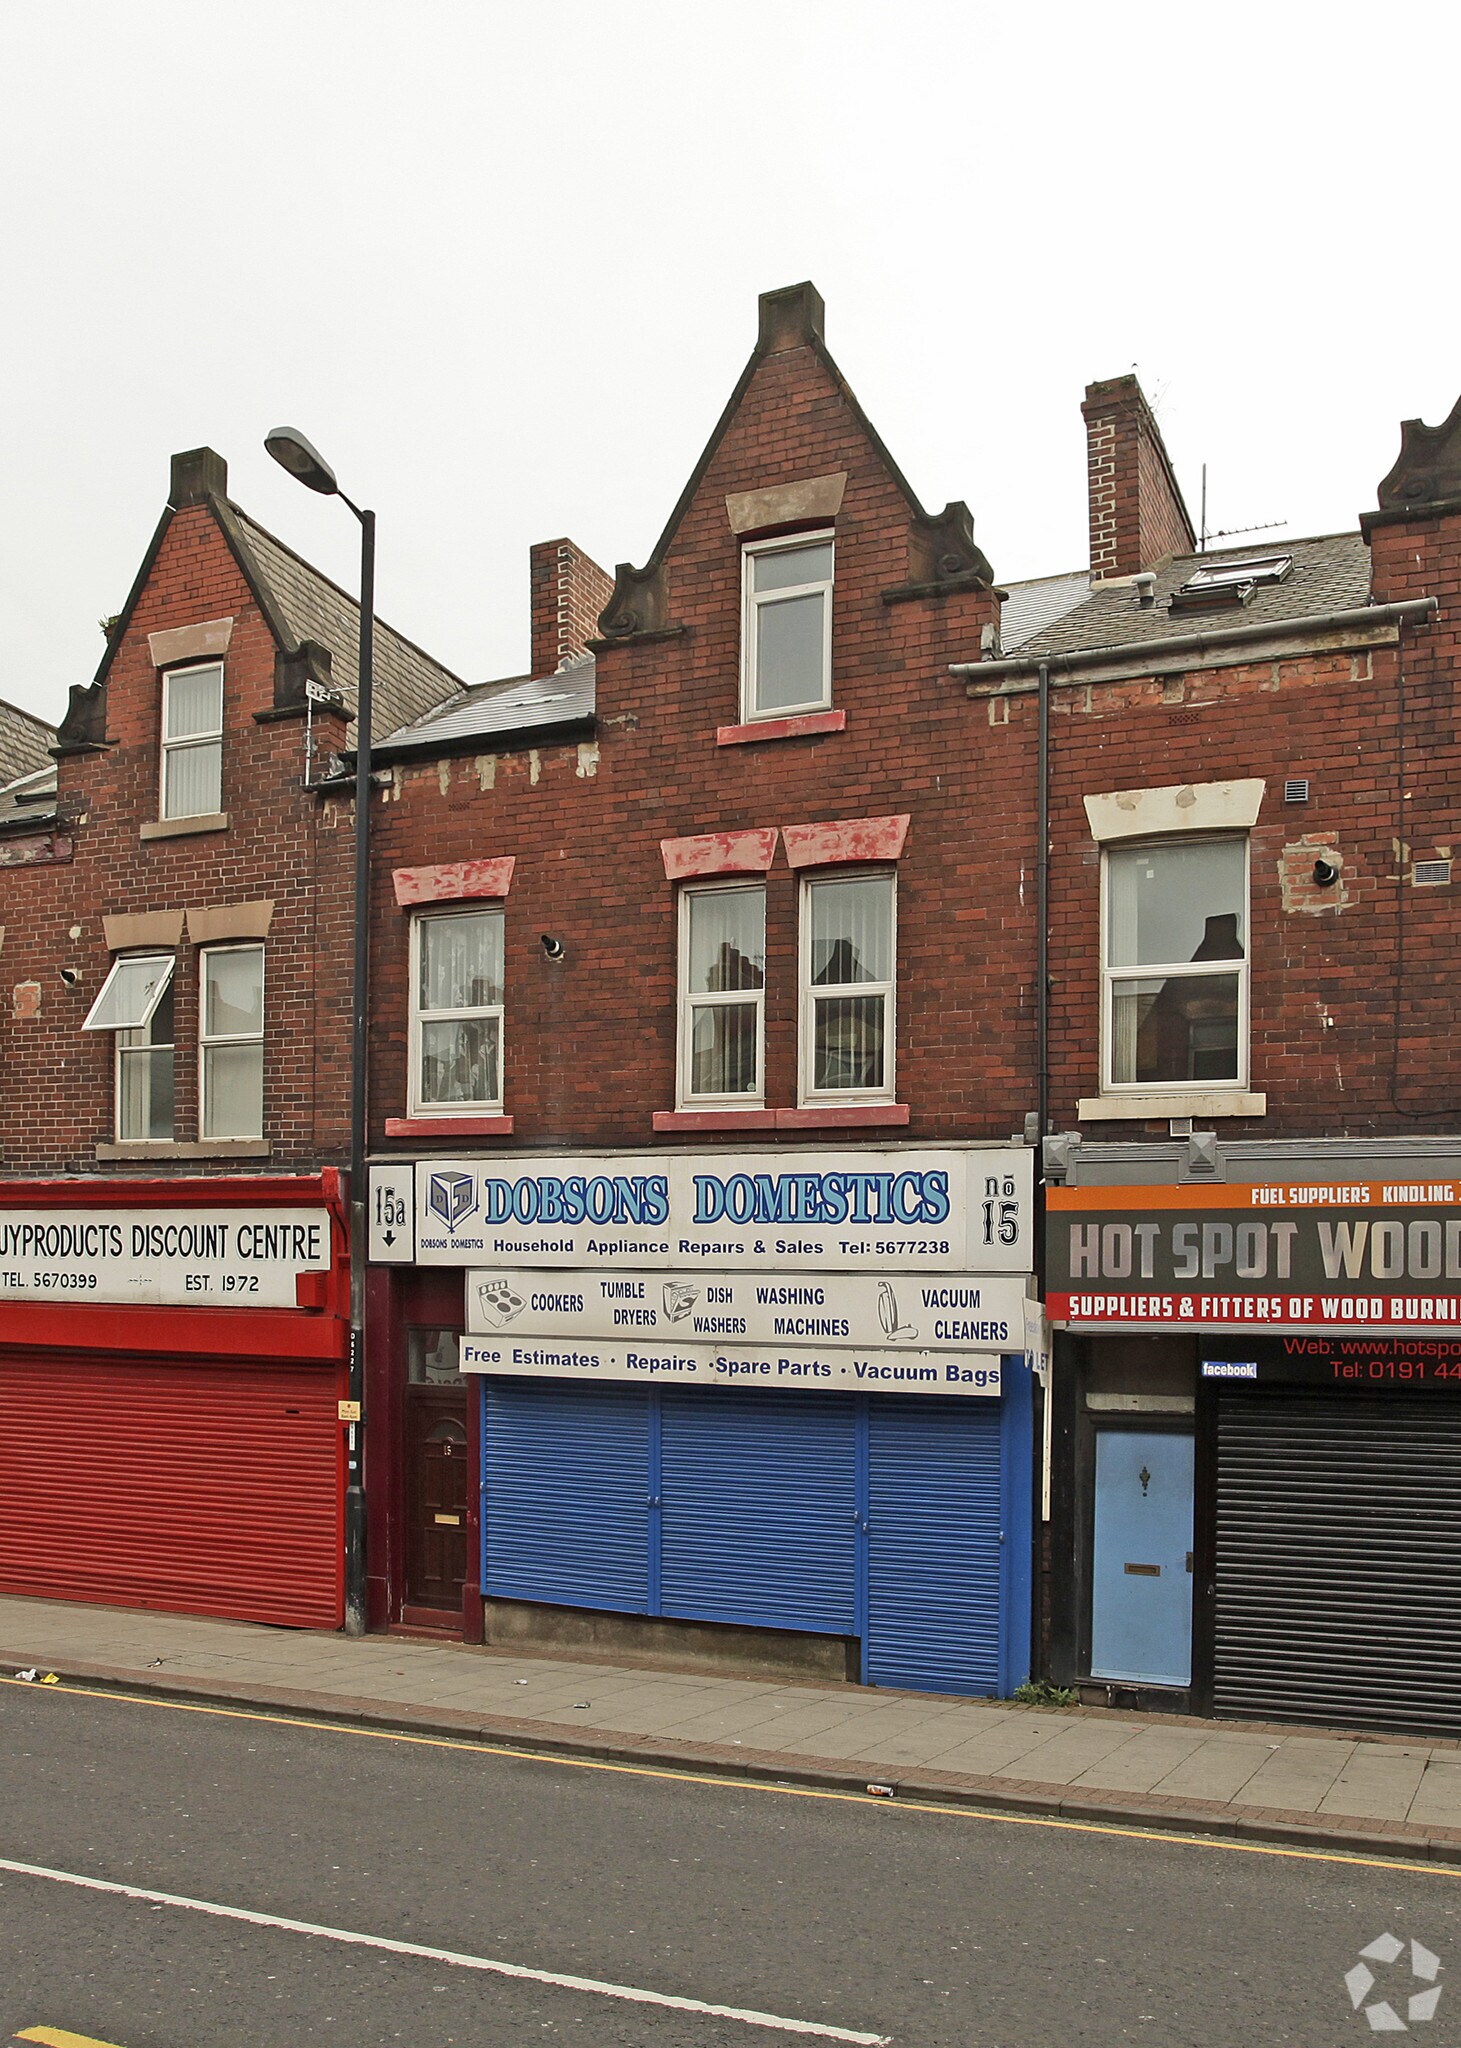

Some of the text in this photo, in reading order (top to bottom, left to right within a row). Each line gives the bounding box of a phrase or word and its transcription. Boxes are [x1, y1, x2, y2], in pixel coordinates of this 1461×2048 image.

[485, 1170, 950, 1225] DOBSONS DOMESTICS
[1252, 1188, 1285, 1204] FUEL
[1290, 1184, 1369, 1203] SUPPLIERS
[1383, 1185, 1453, 1202] KINDLING
[982, 1200, 1019, 1245] 15
[133, 1225, 228, 1258] DISCOUNT
[237, 1225, 320, 1259] CENTRE
[421, 1239, 483, 1248] DOBSONS DOMESTICS
[494, 1239, 949, 1256] Household Appliance Repairs & Sales Tel: 5677238
[1070, 1224, 1160, 1278] HOT
[1173, 1222, 1298, 1278] SPOT
[3, 1272, 96, 1288] TEL. 5670399
[186, 1275, 258, 1291] EST. 1972
[601, 1282, 644, 1298] TUMBLE
[708, 1288, 732, 1303] DISH
[757, 1288, 824, 1305] WASHING
[922, 1289, 980, 1308] VACUUM
[532, 1294, 583, 1312] COOKERS
[1070, 1296, 1461, 1319] SUPPLIERS & FITTERS OF WOOD BURNI
[614, 1309, 656, 1325] DRYERS
[694, 1317, 746, 1333] WASHERS
[775, 1318, 849, 1336] MACHINES
[935, 1320, 1007, 1340] CLEANERS
[1284, 1339, 1333, 1354] Web:
[465, 1347, 1000, 1387] Free Estimates Repairs Spare Parts Vacuum Bags
[1204, 1363, 1256, 1376] facebook
[1330, 1362, 1362, 1377] Tel:
[1370, 1362, 1423, 1378] 0191
